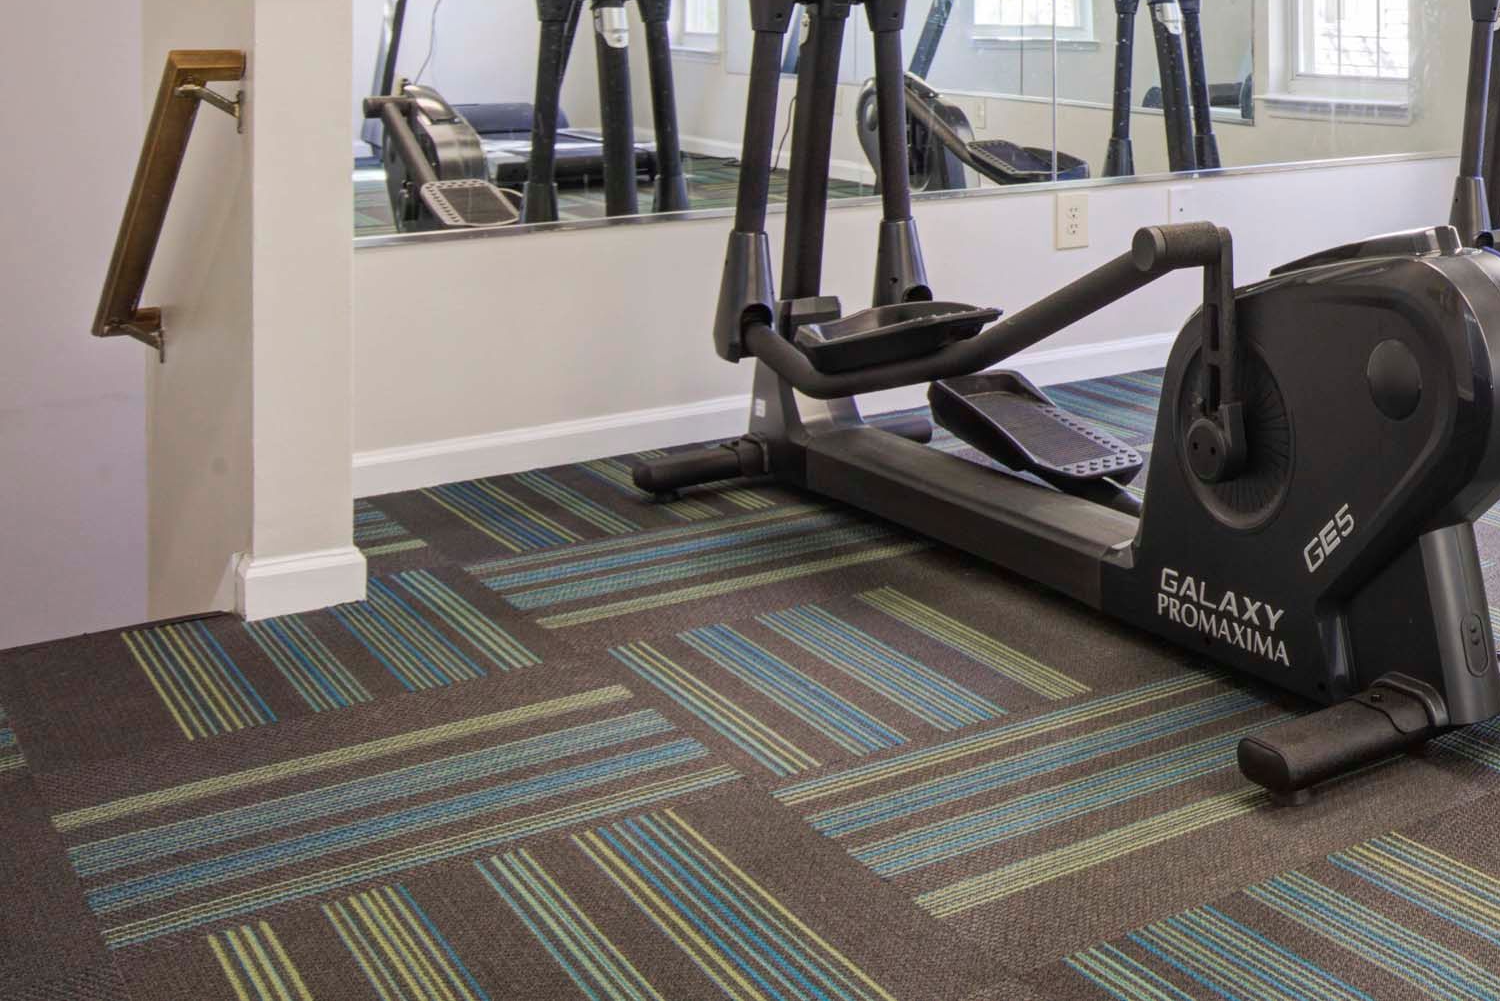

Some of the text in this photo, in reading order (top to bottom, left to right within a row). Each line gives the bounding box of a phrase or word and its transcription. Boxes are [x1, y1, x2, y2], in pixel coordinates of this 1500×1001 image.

[1303, 503, 1356, 573] GE5
[1157, 592, 1290, 667] PROMAXIMA
[1160, 567, 1285, 631] GALAXY
